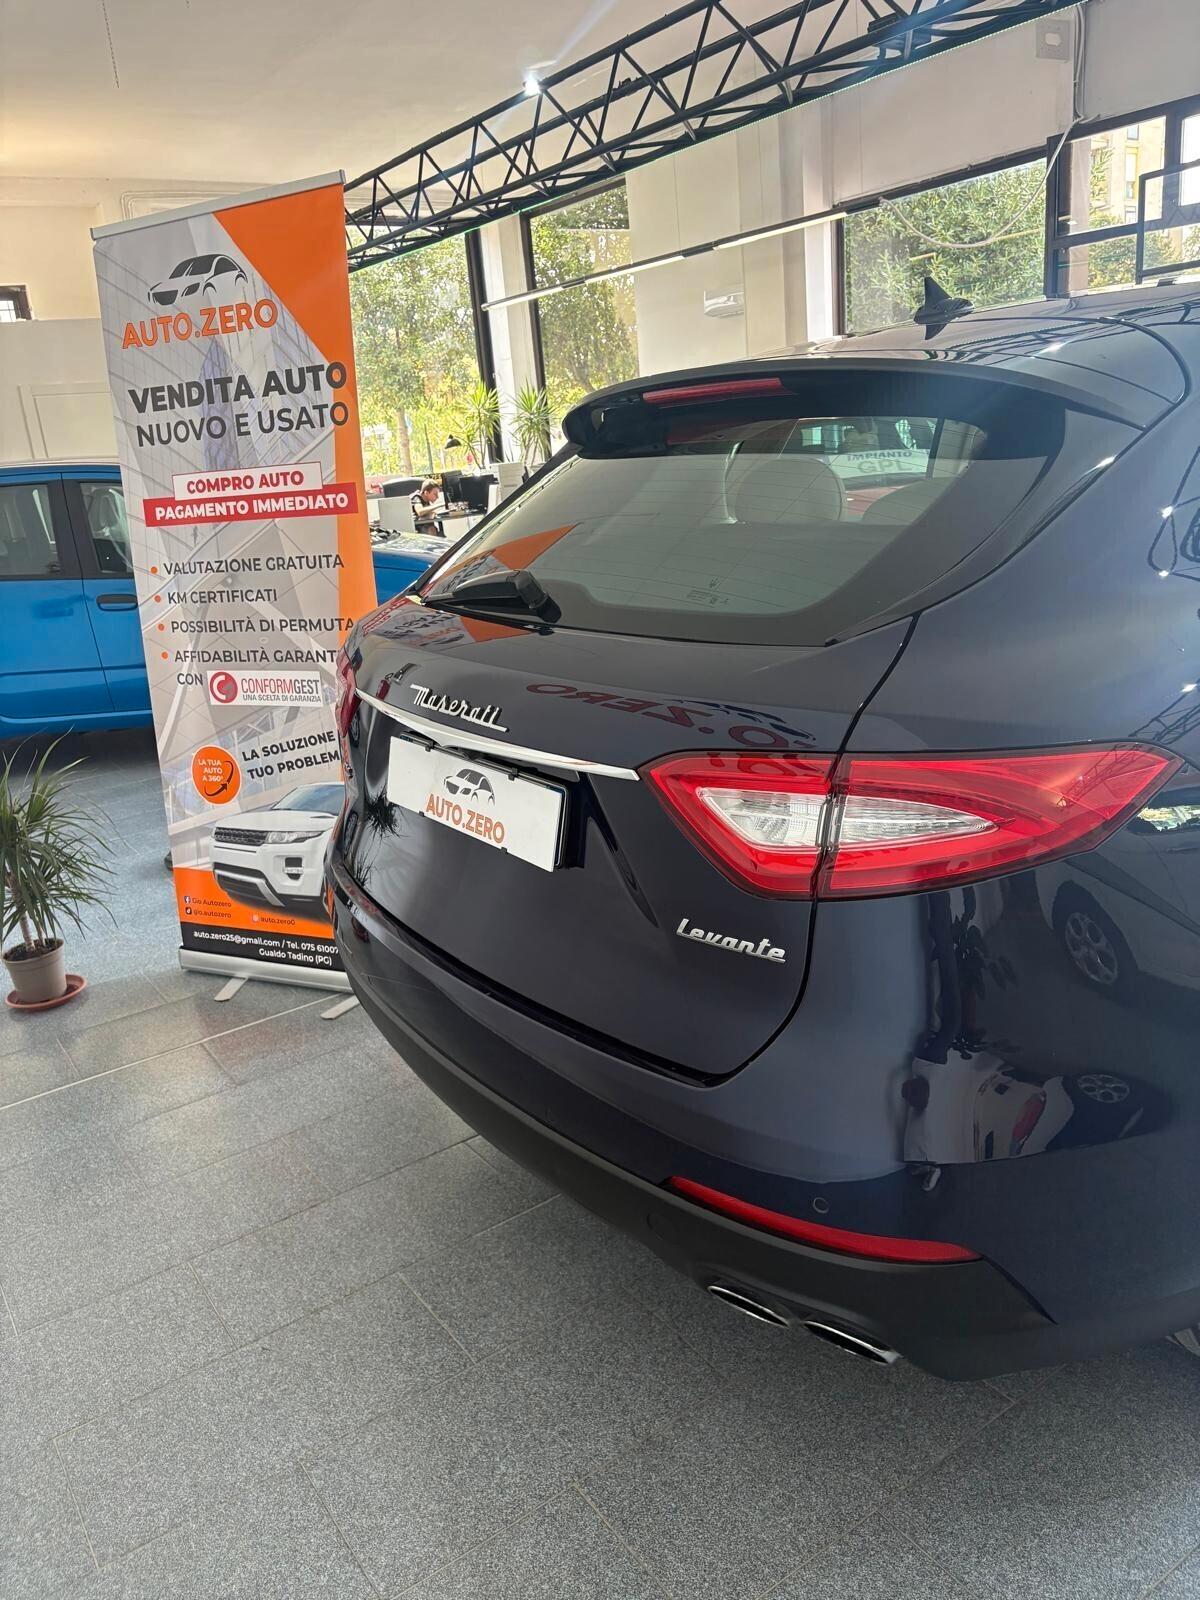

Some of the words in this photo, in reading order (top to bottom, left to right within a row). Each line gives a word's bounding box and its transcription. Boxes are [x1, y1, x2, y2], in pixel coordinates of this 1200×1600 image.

[122, 299, 278, 349] AUTO.ZERO
[128, 374, 255, 413] VENDITA
[262, 362, 347, 397] AUTO
[137, 415, 226, 447] NUOVO
[236, 413, 251, 437] E
[257, 401, 349, 433] USATO
[848, 451, 912, 461] IMPIANTO
[858, 459, 912, 474] GPL
[187, 476, 254, 494] COMPRO
[259, 470, 304, 489] AUTO
[155, 500, 249, 521] PAGAMENTO
[253, 493, 348, 513] IMMEDIATO
[164, 557, 262, 575] VALUTAZIONE
[266, 554, 344, 571] GRATUITA
[167, 591, 187, 604] KM
[190, 589, 277, 604] CERTIFICATI
[171, 616, 254, 633] POSSIBILITÀ
[260, 619, 275, 632] DI
[280, 618, 354, 632] PERMUTA
[174, 647, 270, 663] AFFIDABILITÀ
[273, 649, 339, 663] GARANT
[177, 673, 203, 686] CON
[241, 677, 320, 694] CONFORMGEST
[243, 694, 257, 702] UNA
[258, 694, 280, 702] SCELTA
[410, 683, 509, 733] Maserati
[242, 749, 260, 761] LA
[262, 731, 336, 757] SOLUZIONE
[203, 767, 223, 775] AUTO
[247, 765, 274, 779] TUO
[277, 750, 340, 773] PROBLEM
[426, 793, 505, 844] AUTO.ZERO
[203, 898, 232, 908] Autozero
[193, 931, 280, 947] auto.zero25@gmail.com
[286, 941, 300, 950] Tel.
[301, 942, 316, 952] 075
[676, 918, 786, 963] Levante
[258, 948, 286, 958] Gualdo
[287, 951, 314, 962] Tadino
[315, 954, 332, 966] (PG)
